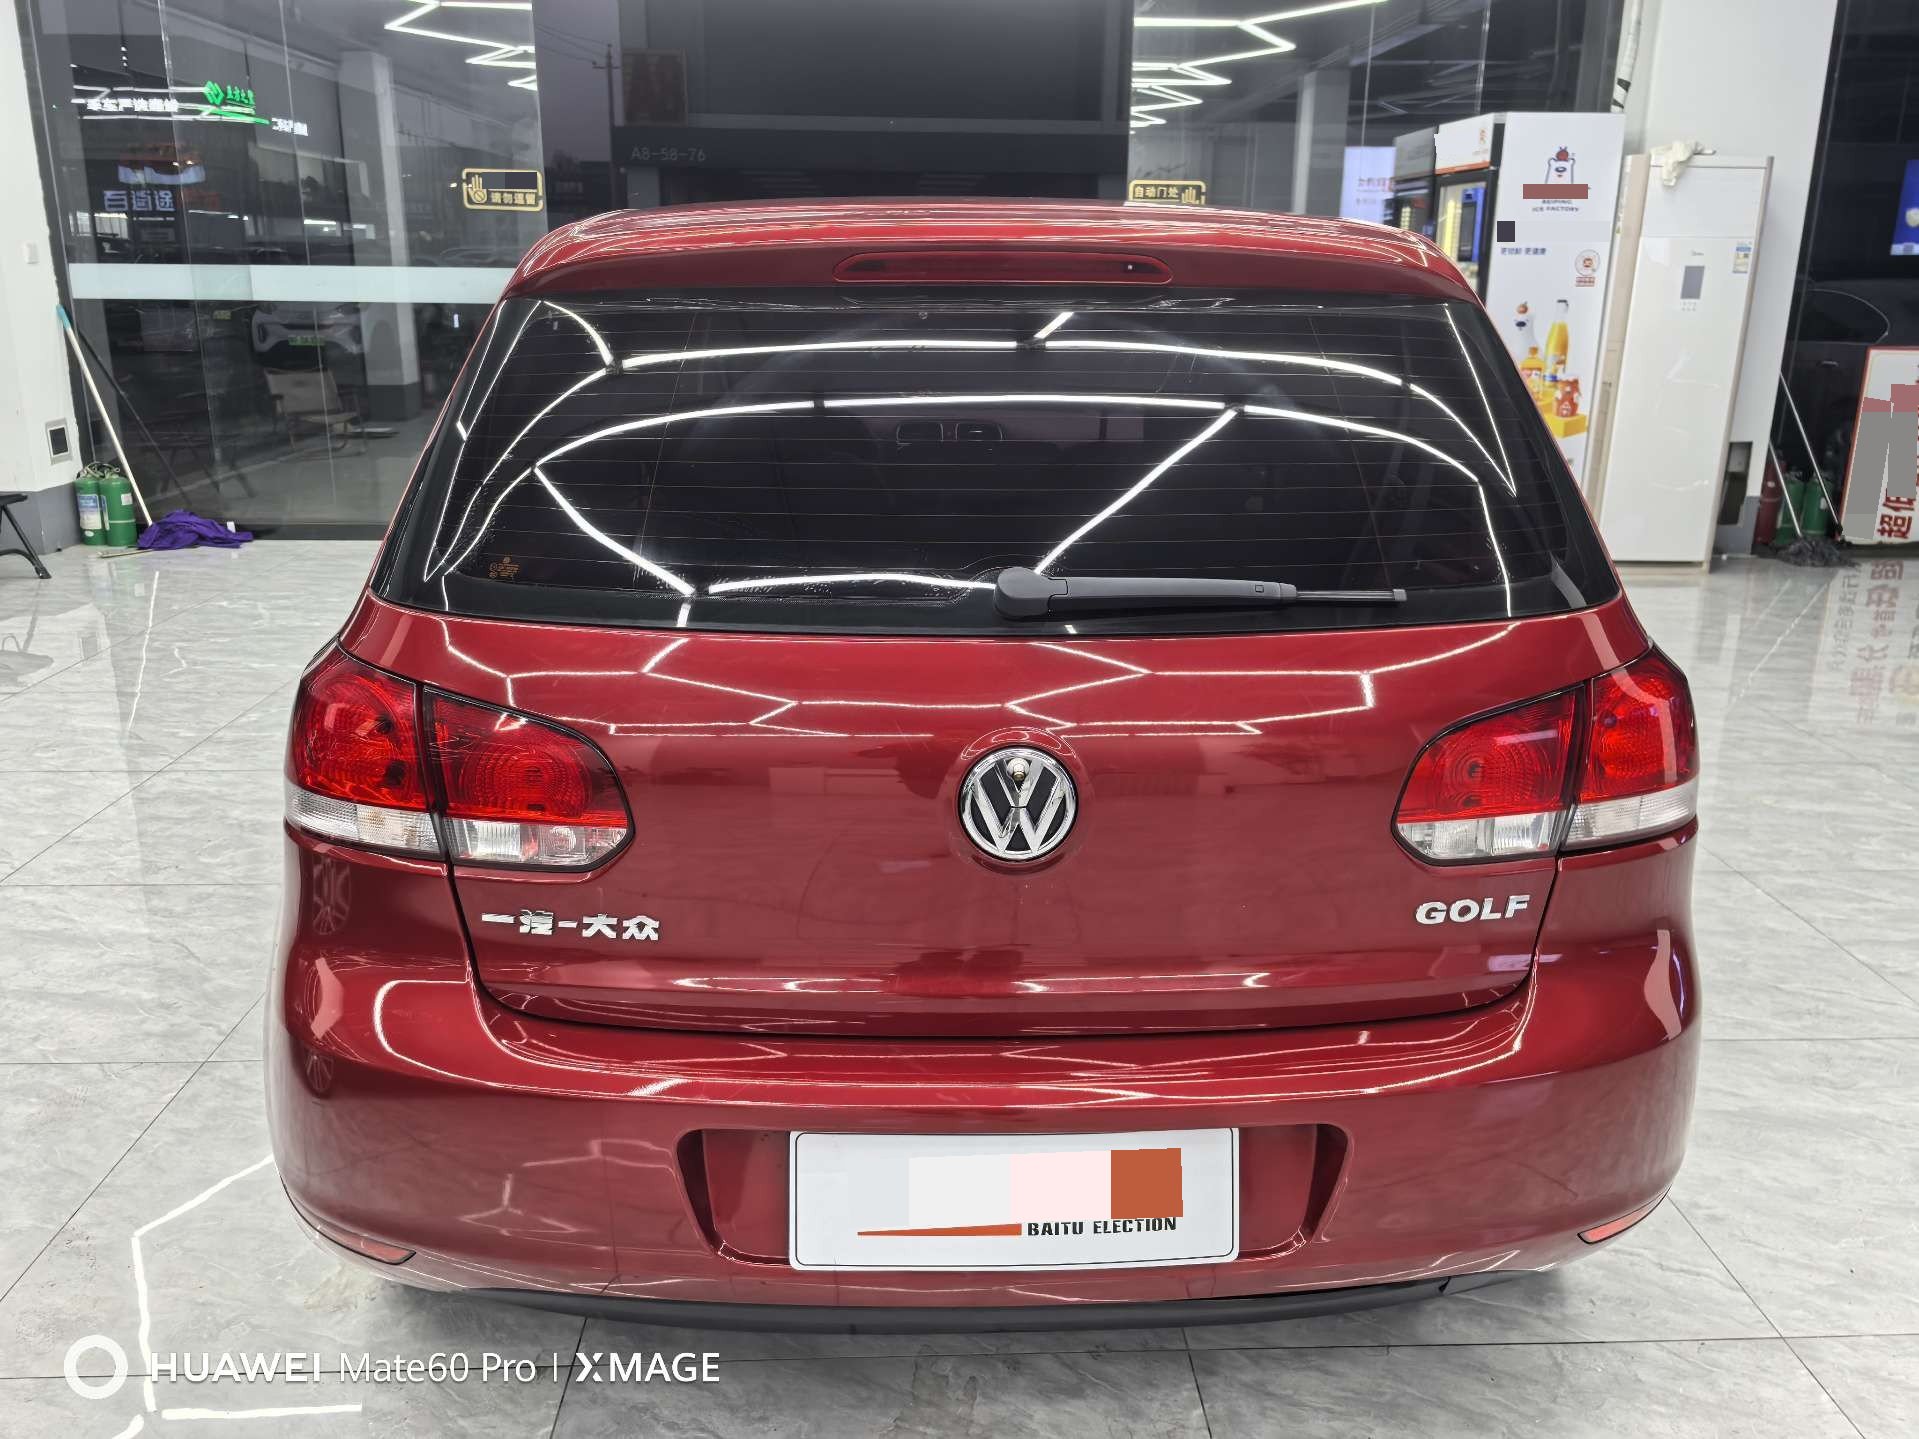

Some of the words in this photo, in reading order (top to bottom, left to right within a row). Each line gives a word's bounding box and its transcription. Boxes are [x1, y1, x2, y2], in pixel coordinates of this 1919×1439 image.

[1415, 894, 1531, 925] GOLF
[1027, 1221, 1084, 1236] BAITU
[1093, 1217, 1177, 1234] ELECTION
